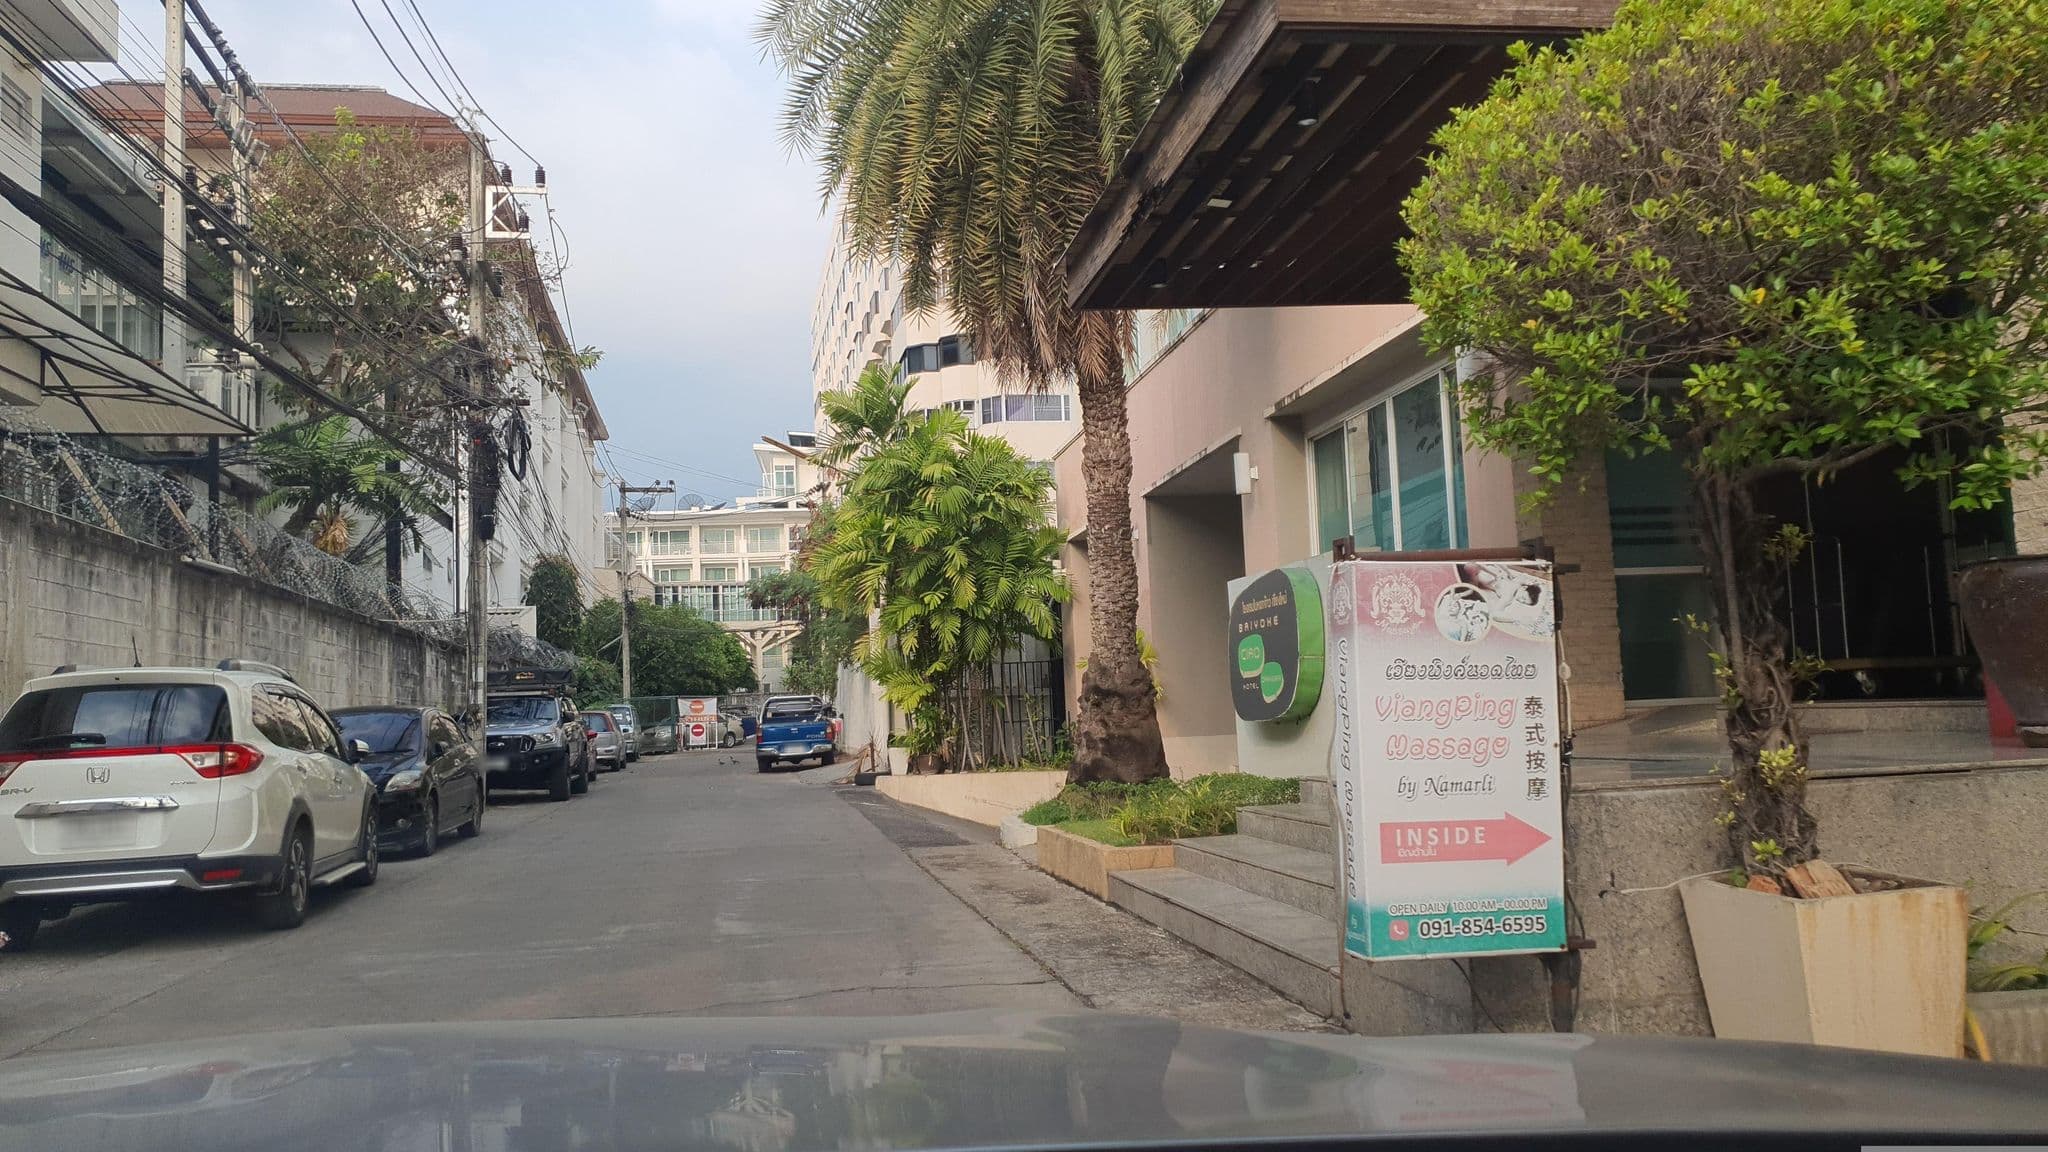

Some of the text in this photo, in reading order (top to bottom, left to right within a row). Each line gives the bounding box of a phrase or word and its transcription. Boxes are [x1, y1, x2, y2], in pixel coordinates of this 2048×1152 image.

[1375, 692, 1518, 728] ViangPing
[1386, 734, 1510, 767] Massage
[1523, 695, 1549, 799] 泰式按摩
[1397, 773, 1495, 799] by Namarli
[1395, 826, 1487, 848] INSIDE
[1389, 903, 1417, 915] OPEN
[1420, 902, 1447, 914] DAILY
[1481, 900, 1496, 910] AM
[1531, 898, 1546, 908] PM
[1419, 915, 1546, 937] 091-854-6595
